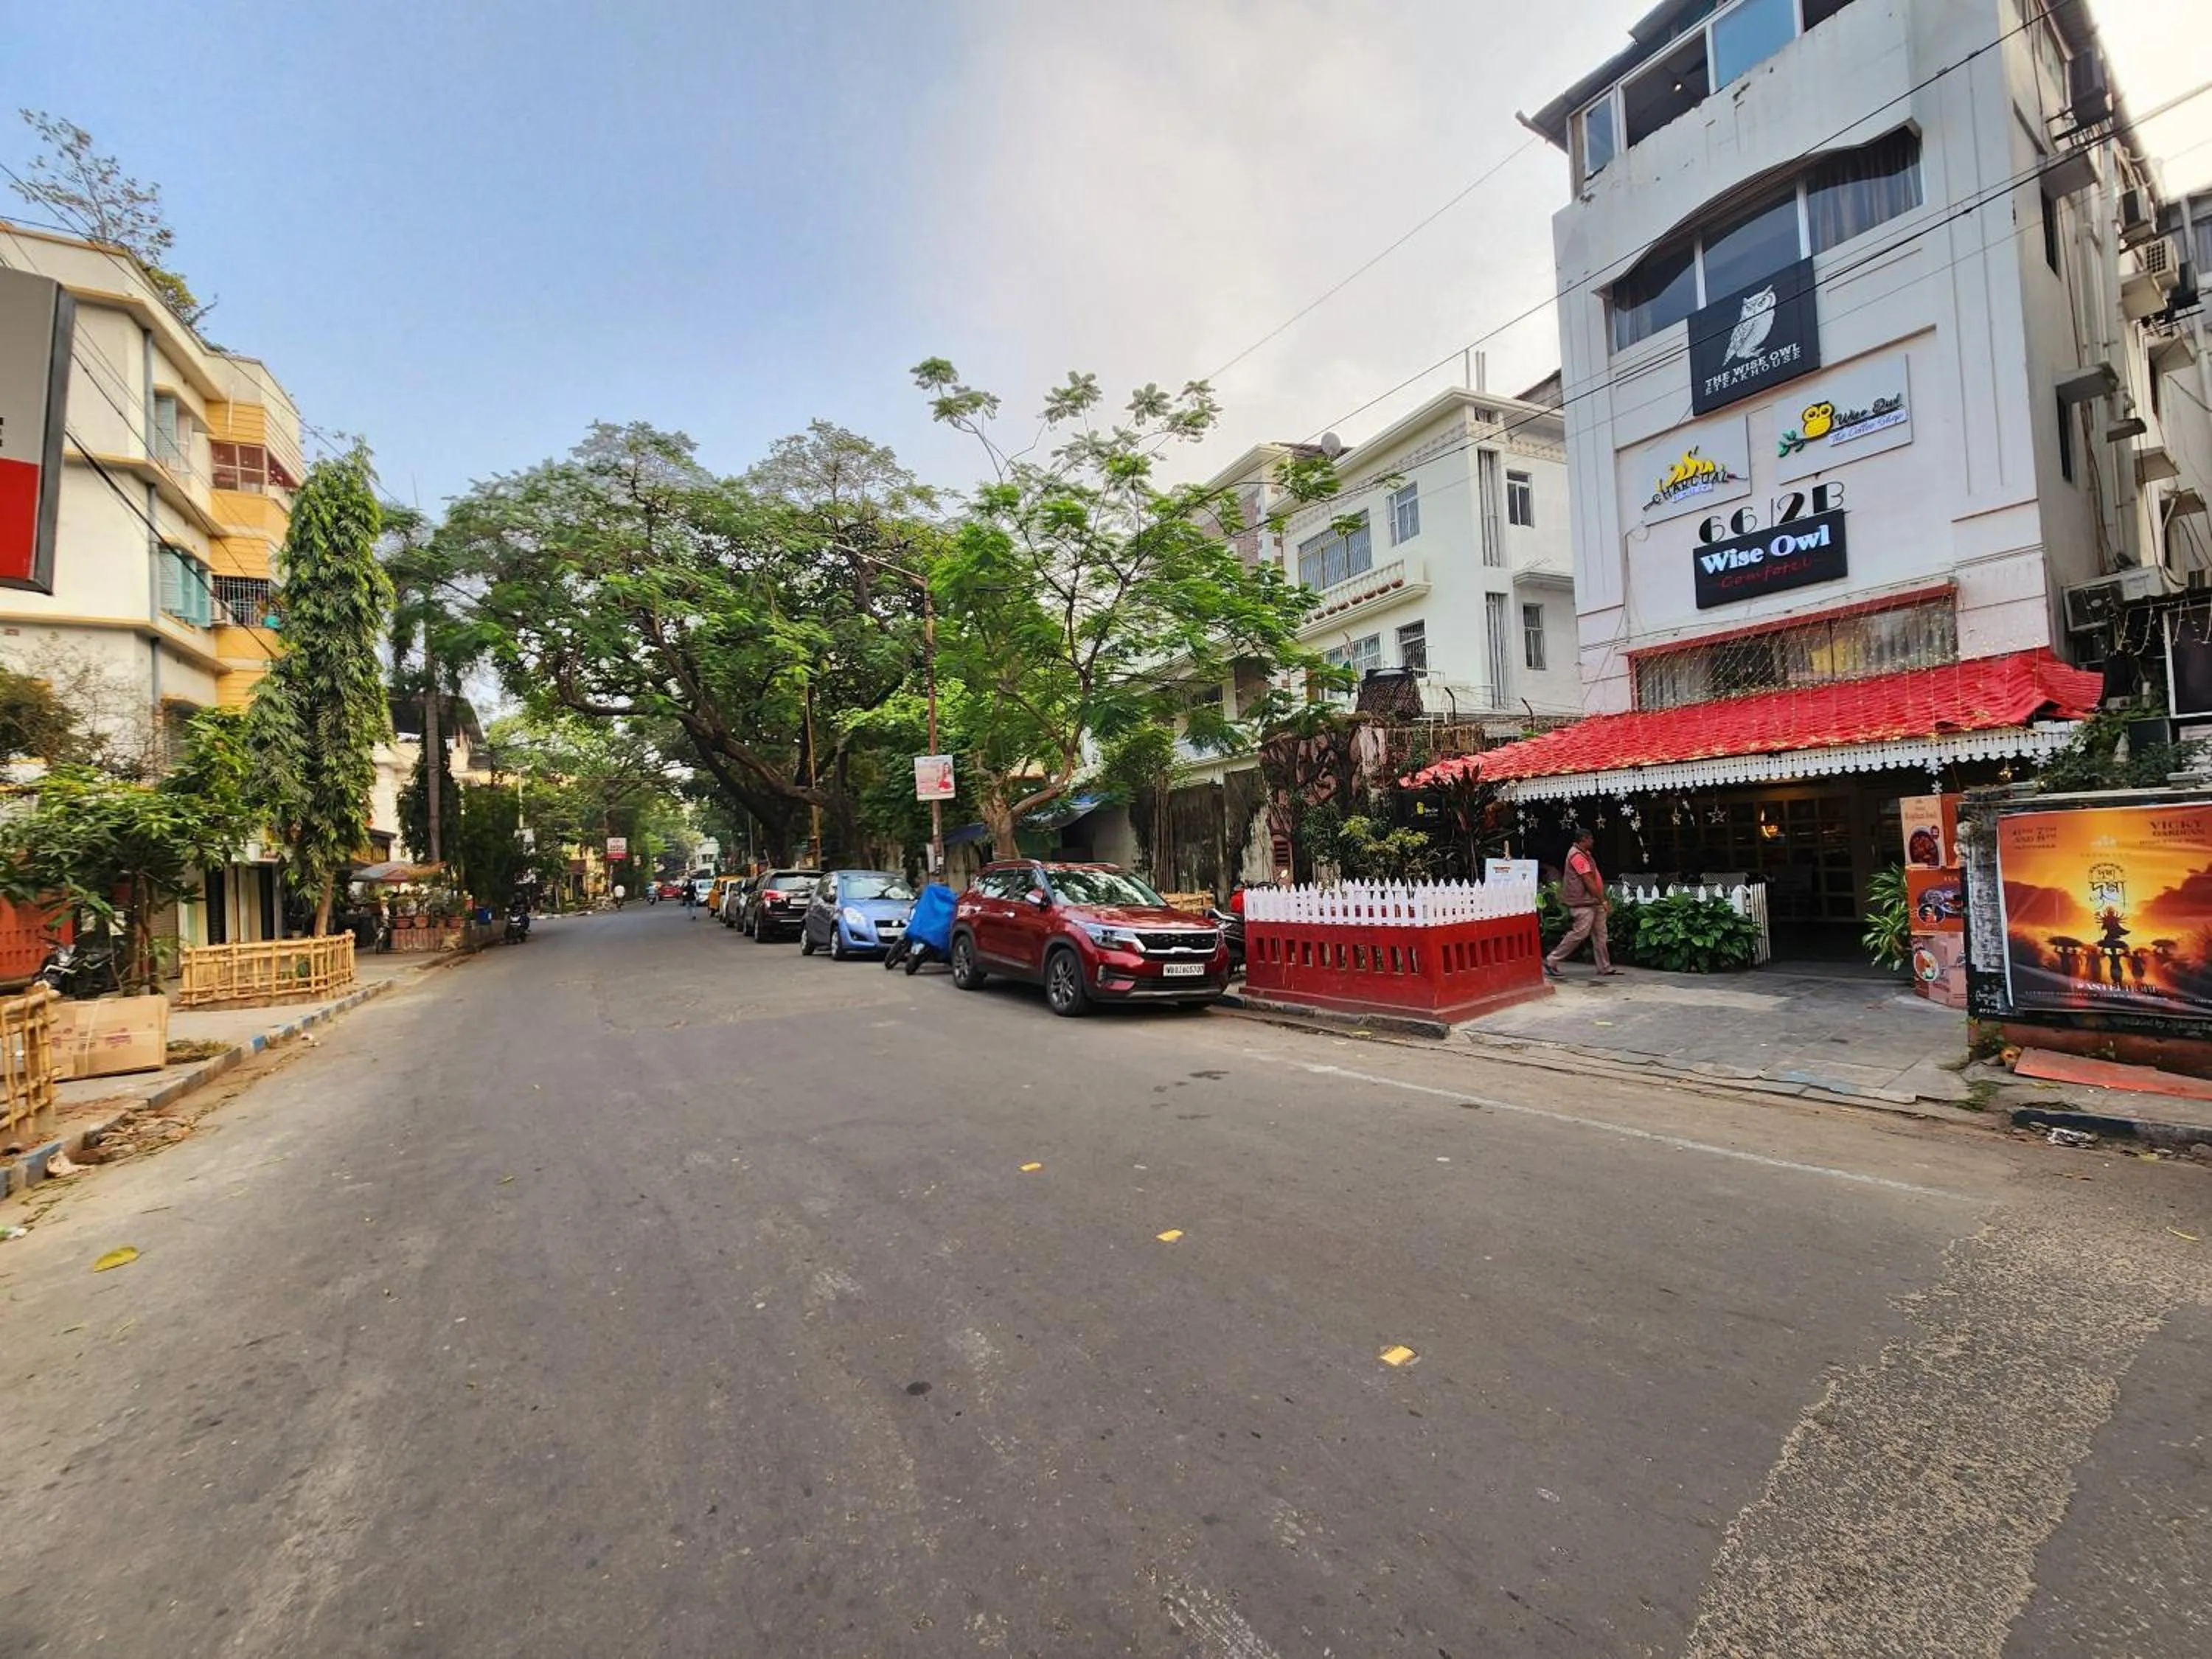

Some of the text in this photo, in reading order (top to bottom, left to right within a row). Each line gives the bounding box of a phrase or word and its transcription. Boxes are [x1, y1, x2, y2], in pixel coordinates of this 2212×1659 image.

[1705, 342, 1801, 387] THE WISE OWL
[1705, 350, 1801, 395] STEAKHOUSE
[1834, 393, 1901, 425] Wise Owl
[1848, 422, 1875, 437] Coffee
[1877, 413, 1904, 425] Shop
[1700, 524, 1832, 574] Wise Owl
